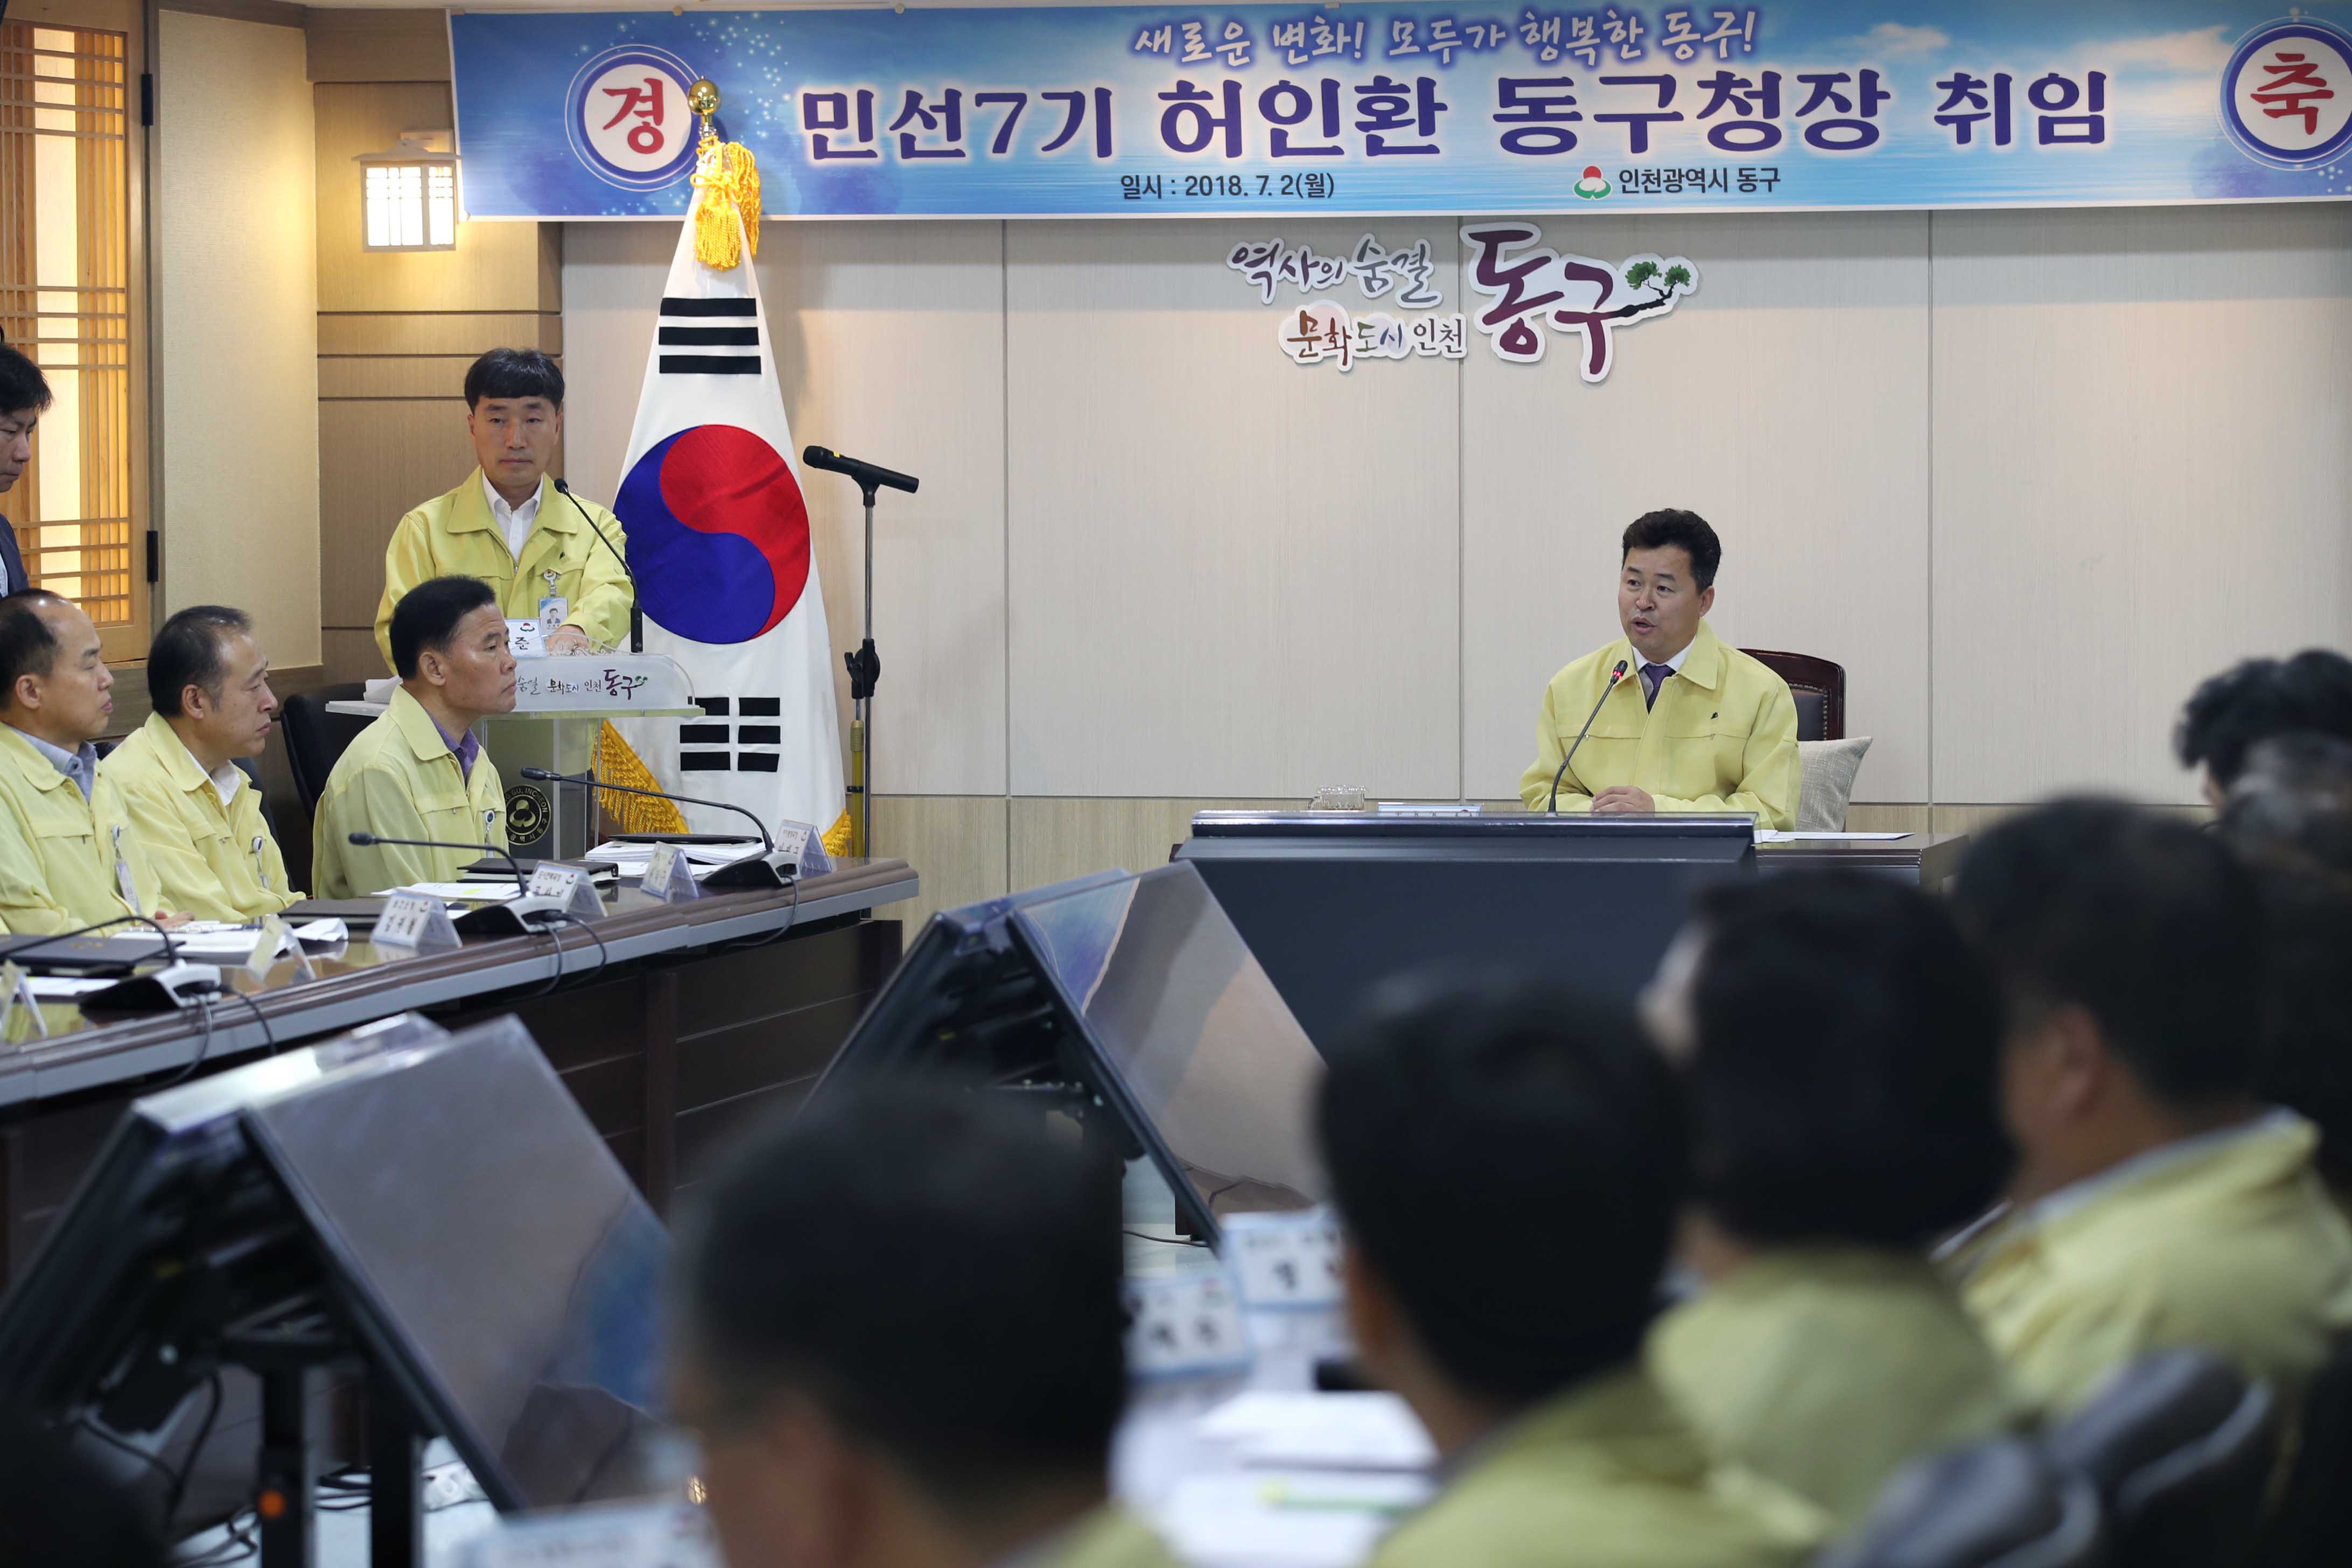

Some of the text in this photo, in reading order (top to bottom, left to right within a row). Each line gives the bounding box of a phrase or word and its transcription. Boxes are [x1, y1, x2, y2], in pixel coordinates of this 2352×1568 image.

[1135, 9, 1755, 66] 새로운 변화! 모두가 행복한 동구!
[603, 77, 665, 155] 경
[803, 69, 2106, 160] 민선7기 허인환 동구청장 취임
[2250, 53, 2334, 135] 축
[1121, 174, 1162, 200] 일시
[1185, 174, 1248, 197] 2018.
[1280, 172, 1335, 199] 2(월)
[1619, 167, 1781, 194] 인천광역시 동구
[1232, 239, 1440, 305] 역사의 숨결
[1467, 229, 1616, 375] 동구
[1286, 310, 1465, 366] 문화도시 인천
[517, 669, 637, 700] 숨결 문화도시 인천 동구
